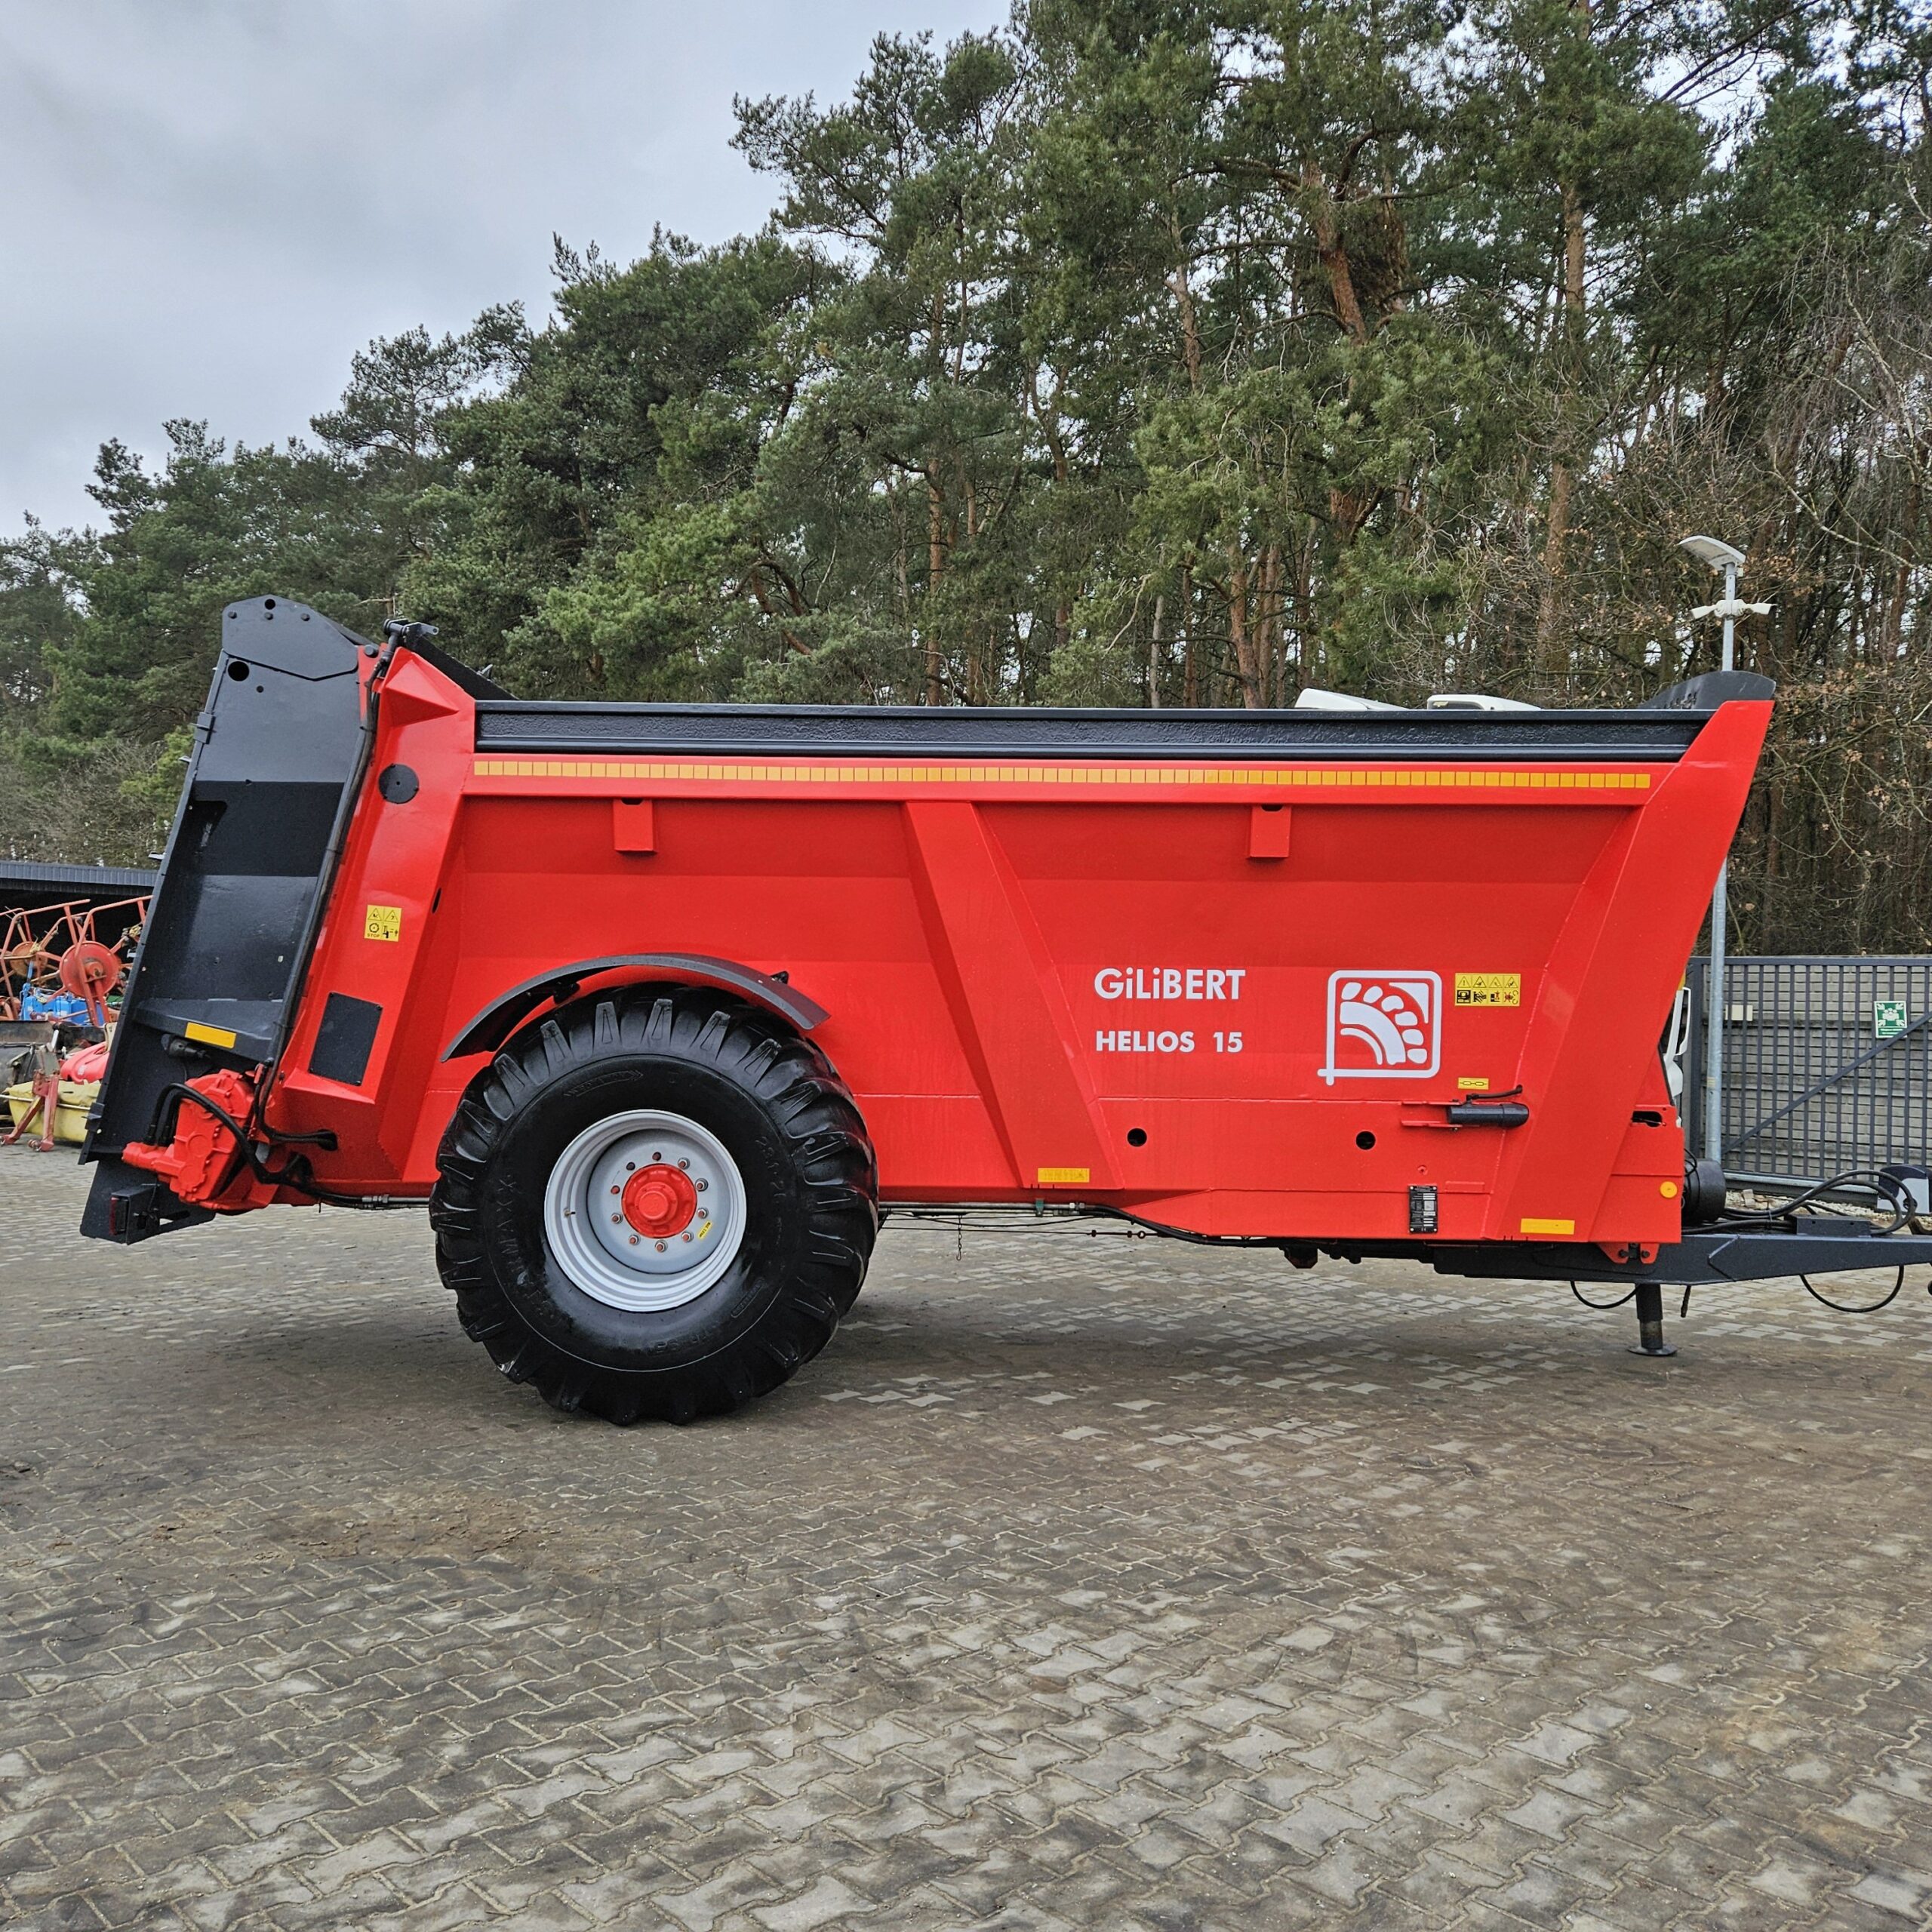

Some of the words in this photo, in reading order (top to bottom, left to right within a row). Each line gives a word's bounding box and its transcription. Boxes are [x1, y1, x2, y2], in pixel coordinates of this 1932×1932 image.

[1094, 967, 1246, 1000] GiLiBERT
[1096, 1030, 1195, 1053] HELIOS
[1213, 1031, 1243, 1053] 15
